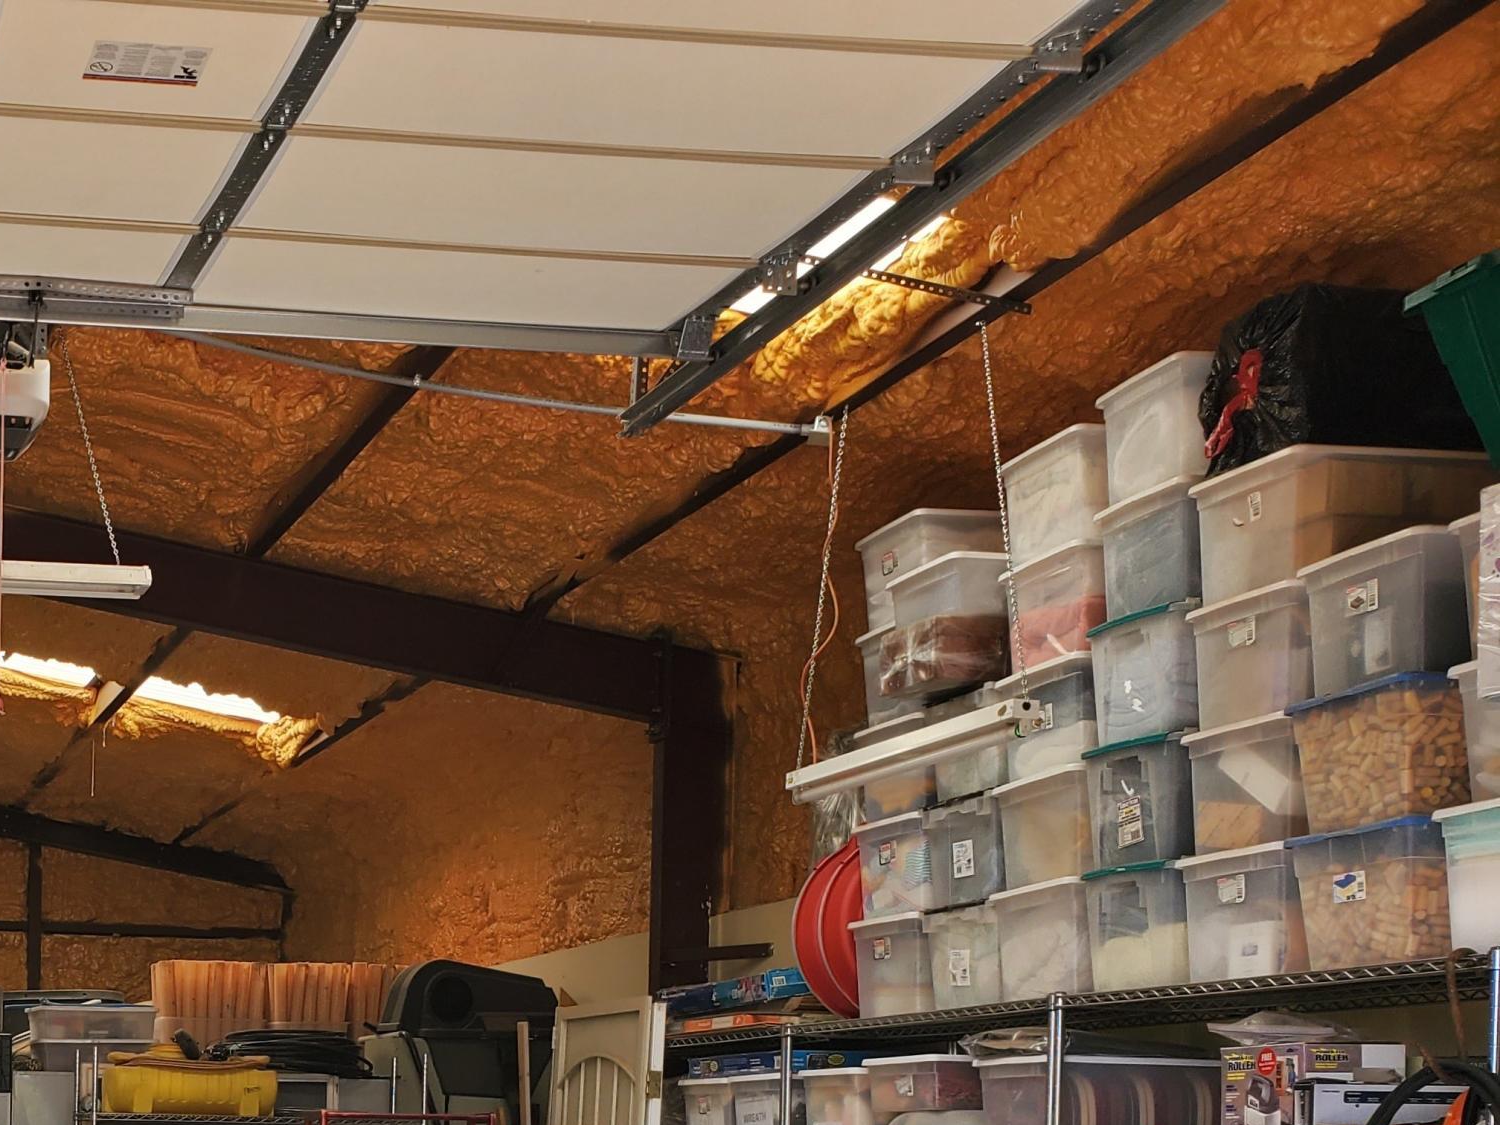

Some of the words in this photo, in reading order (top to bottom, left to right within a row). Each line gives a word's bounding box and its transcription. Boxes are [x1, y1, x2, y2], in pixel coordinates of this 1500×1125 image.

[1315, 1054, 1349, 1062] ROLLER
[1228, 1060, 1256, 1072] ROLLER
[743, 1112, 767, 1124] WREATH
